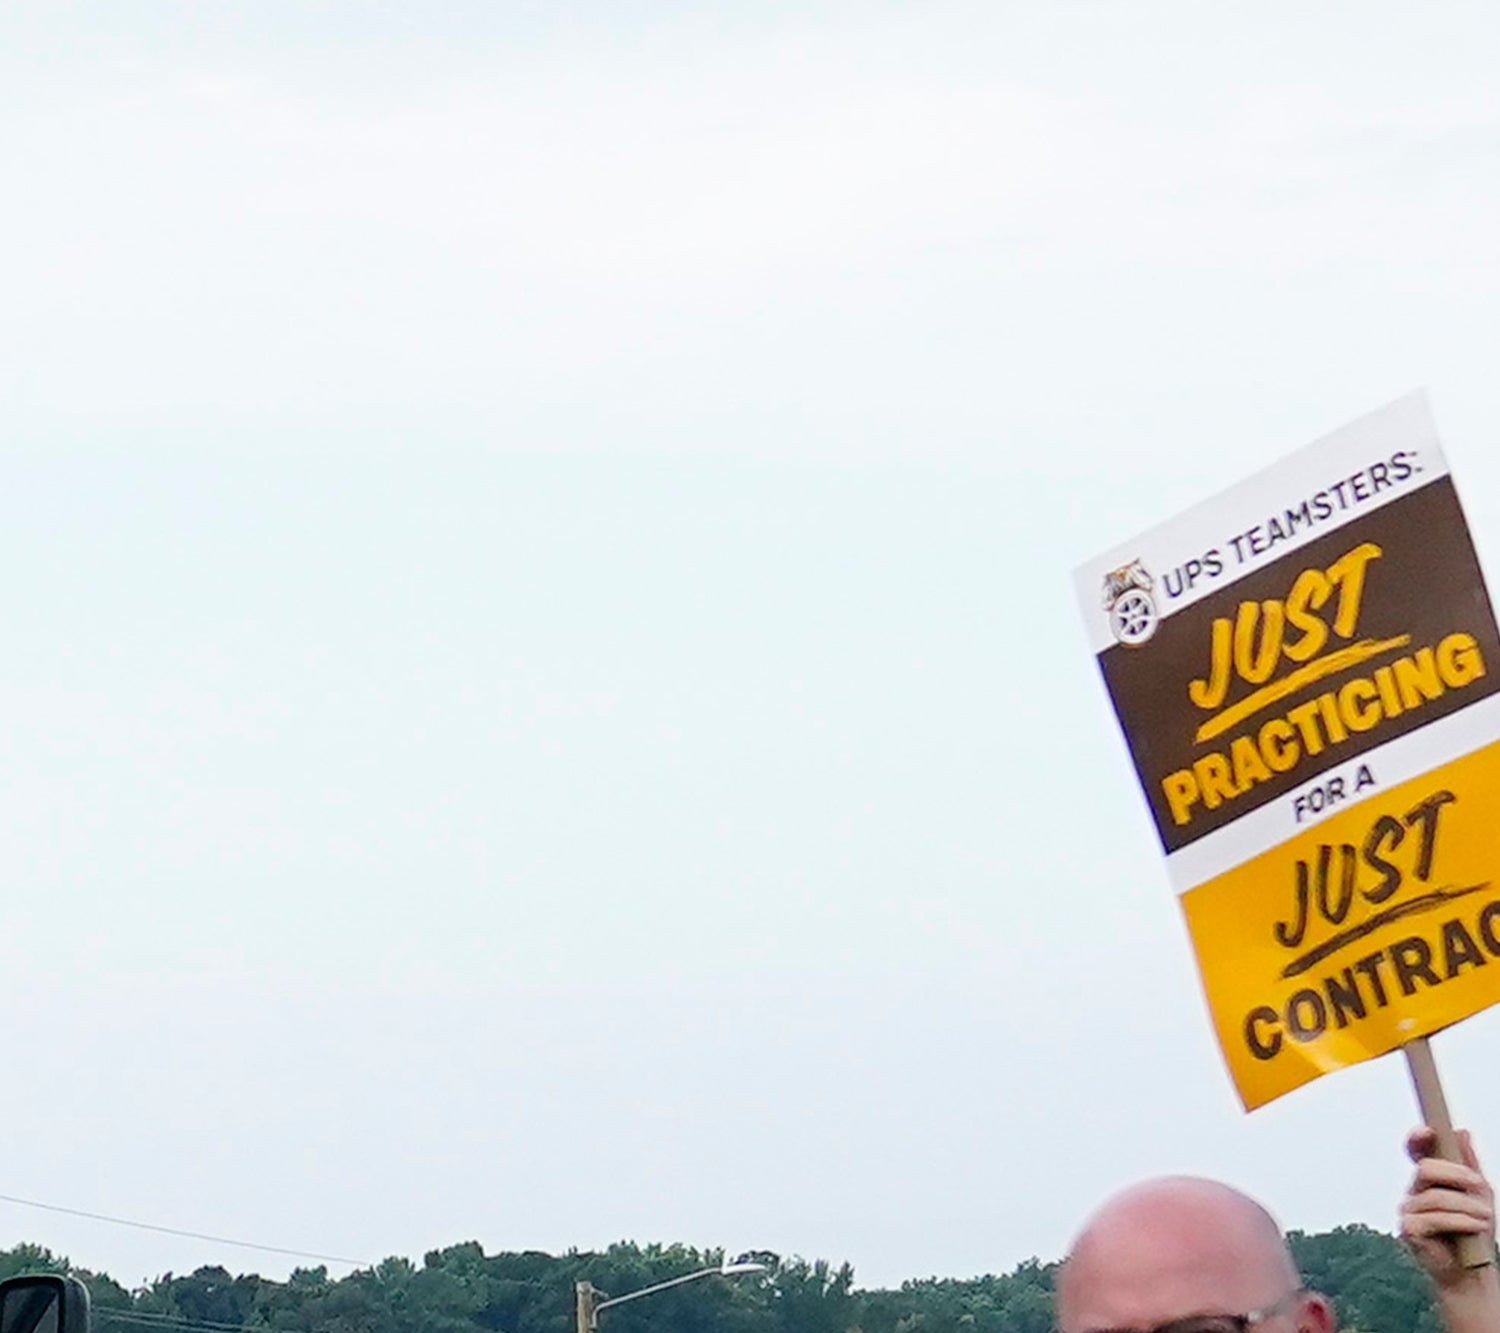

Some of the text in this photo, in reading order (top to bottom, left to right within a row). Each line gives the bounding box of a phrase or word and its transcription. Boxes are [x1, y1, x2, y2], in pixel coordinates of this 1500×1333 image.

[1162, 449, 1424, 600] UPS TEAMSTERS:
[1189, 541, 1383, 709] JUST
[1161, 631, 1487, 826] PRACTICING
[1292, 763, 1376, 822] FOR A
[1275, 789, 1457, 949] JUST
